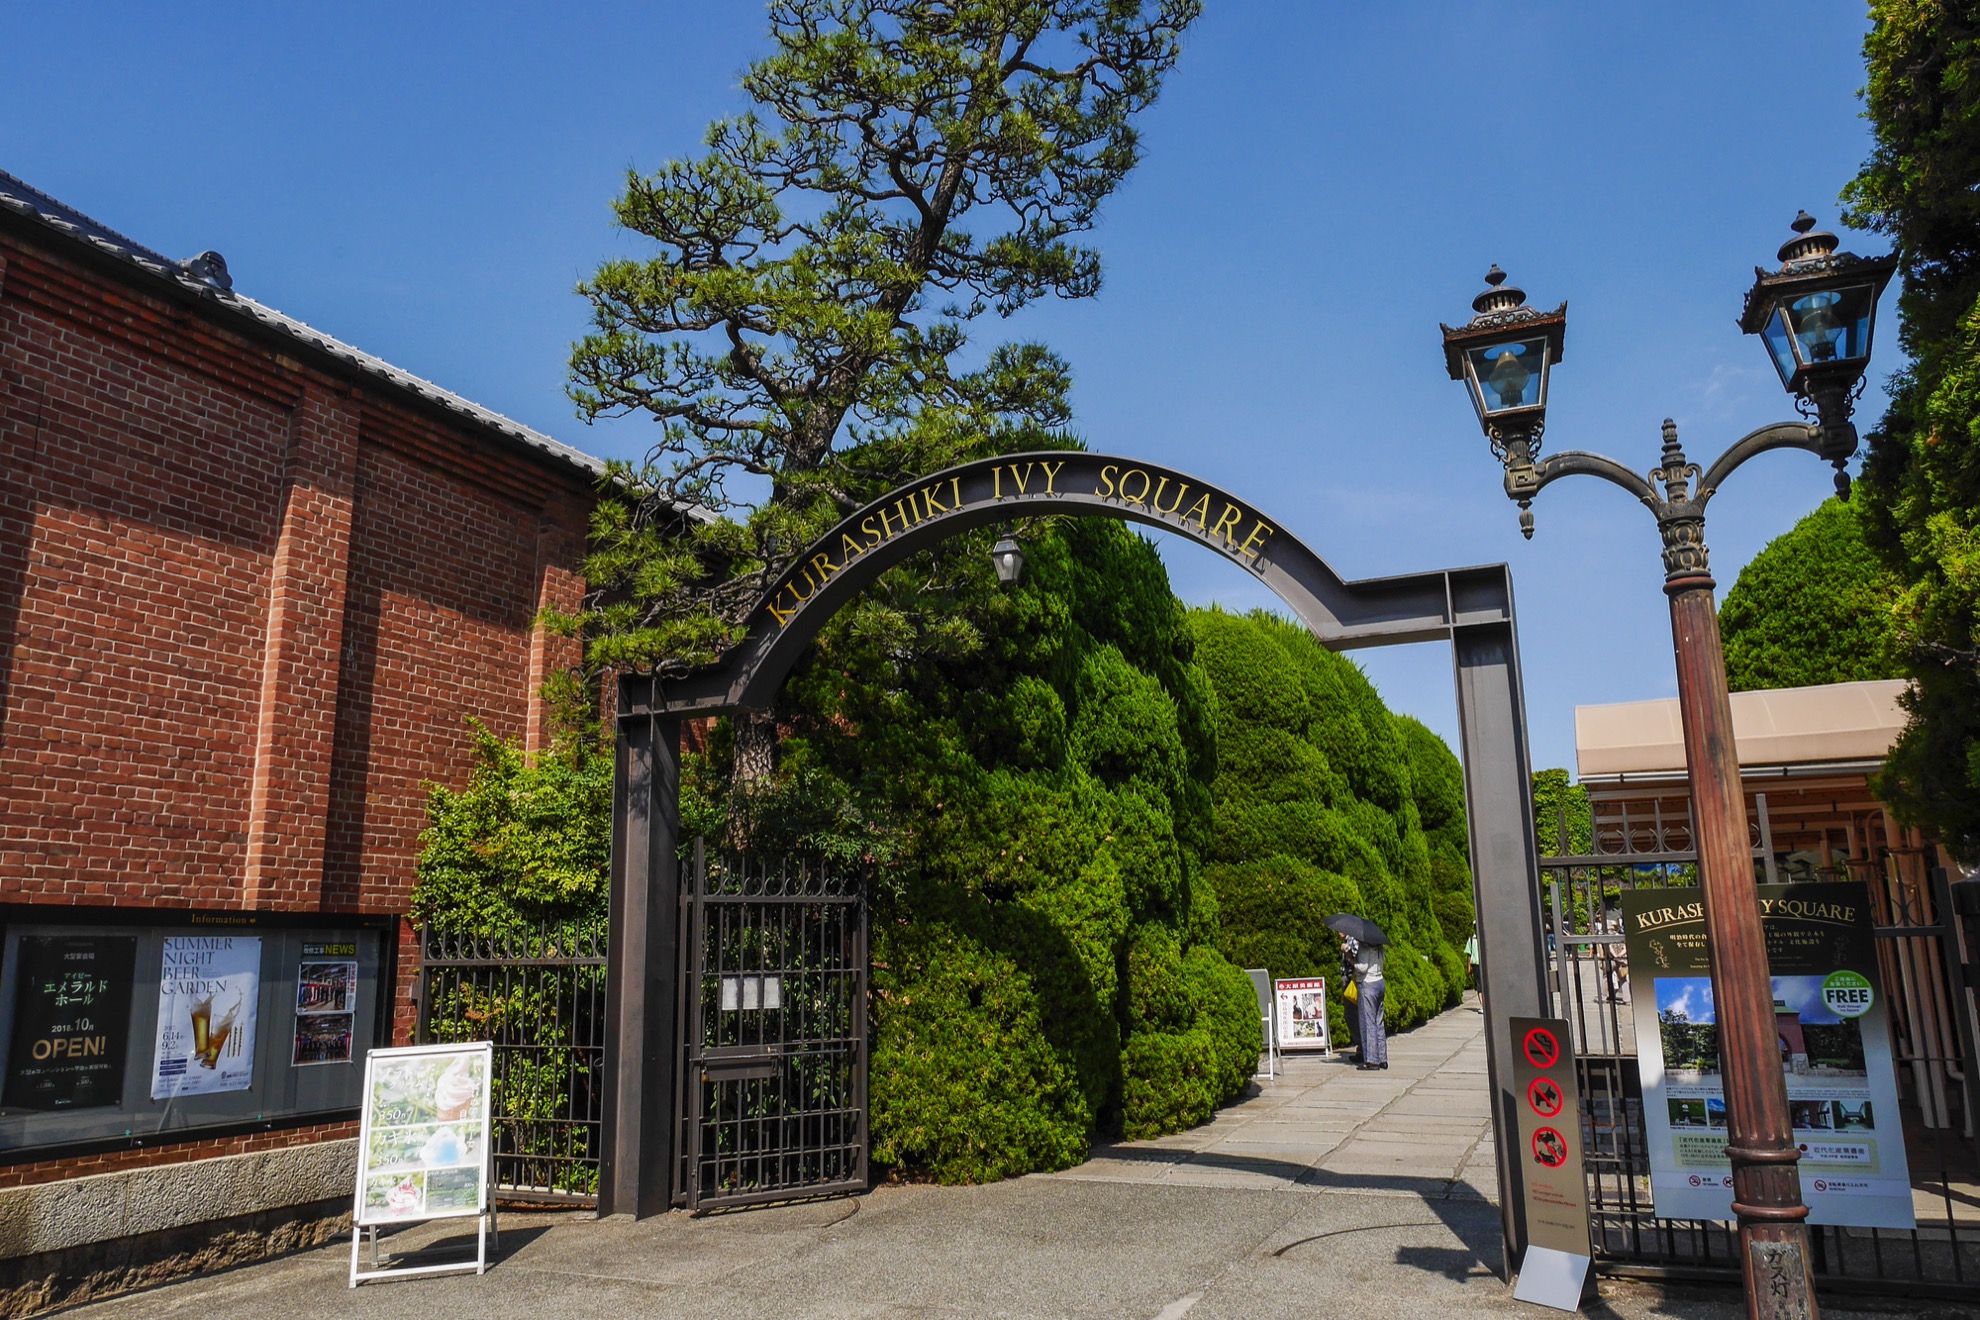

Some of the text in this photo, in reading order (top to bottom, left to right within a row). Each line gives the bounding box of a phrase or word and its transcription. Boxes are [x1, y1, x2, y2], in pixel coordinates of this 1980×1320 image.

[765, 461, 1274, 628] KURASHIKI IVY SQUARE
[1778, 899, 1855, 922] SQUARE
[192, 914, 247, 924] Information
[164, 938, 233, 950] SUMMER
[325, 944, 355, 954] NEWS
[164, 952, 215, 965] NIGHT
[163, 966, 200, 980] BEER
[44, 980, 108, 993] エメラルド
[161, 980, 228, 995] GARDEN
[55, 994, 95, 1006] ホール
[1826, 989, 1869, 1003] FREE
[32, 1036, 106, 1060] OPEN!
[1768, 1249, 1790, 1299] ガス灯
